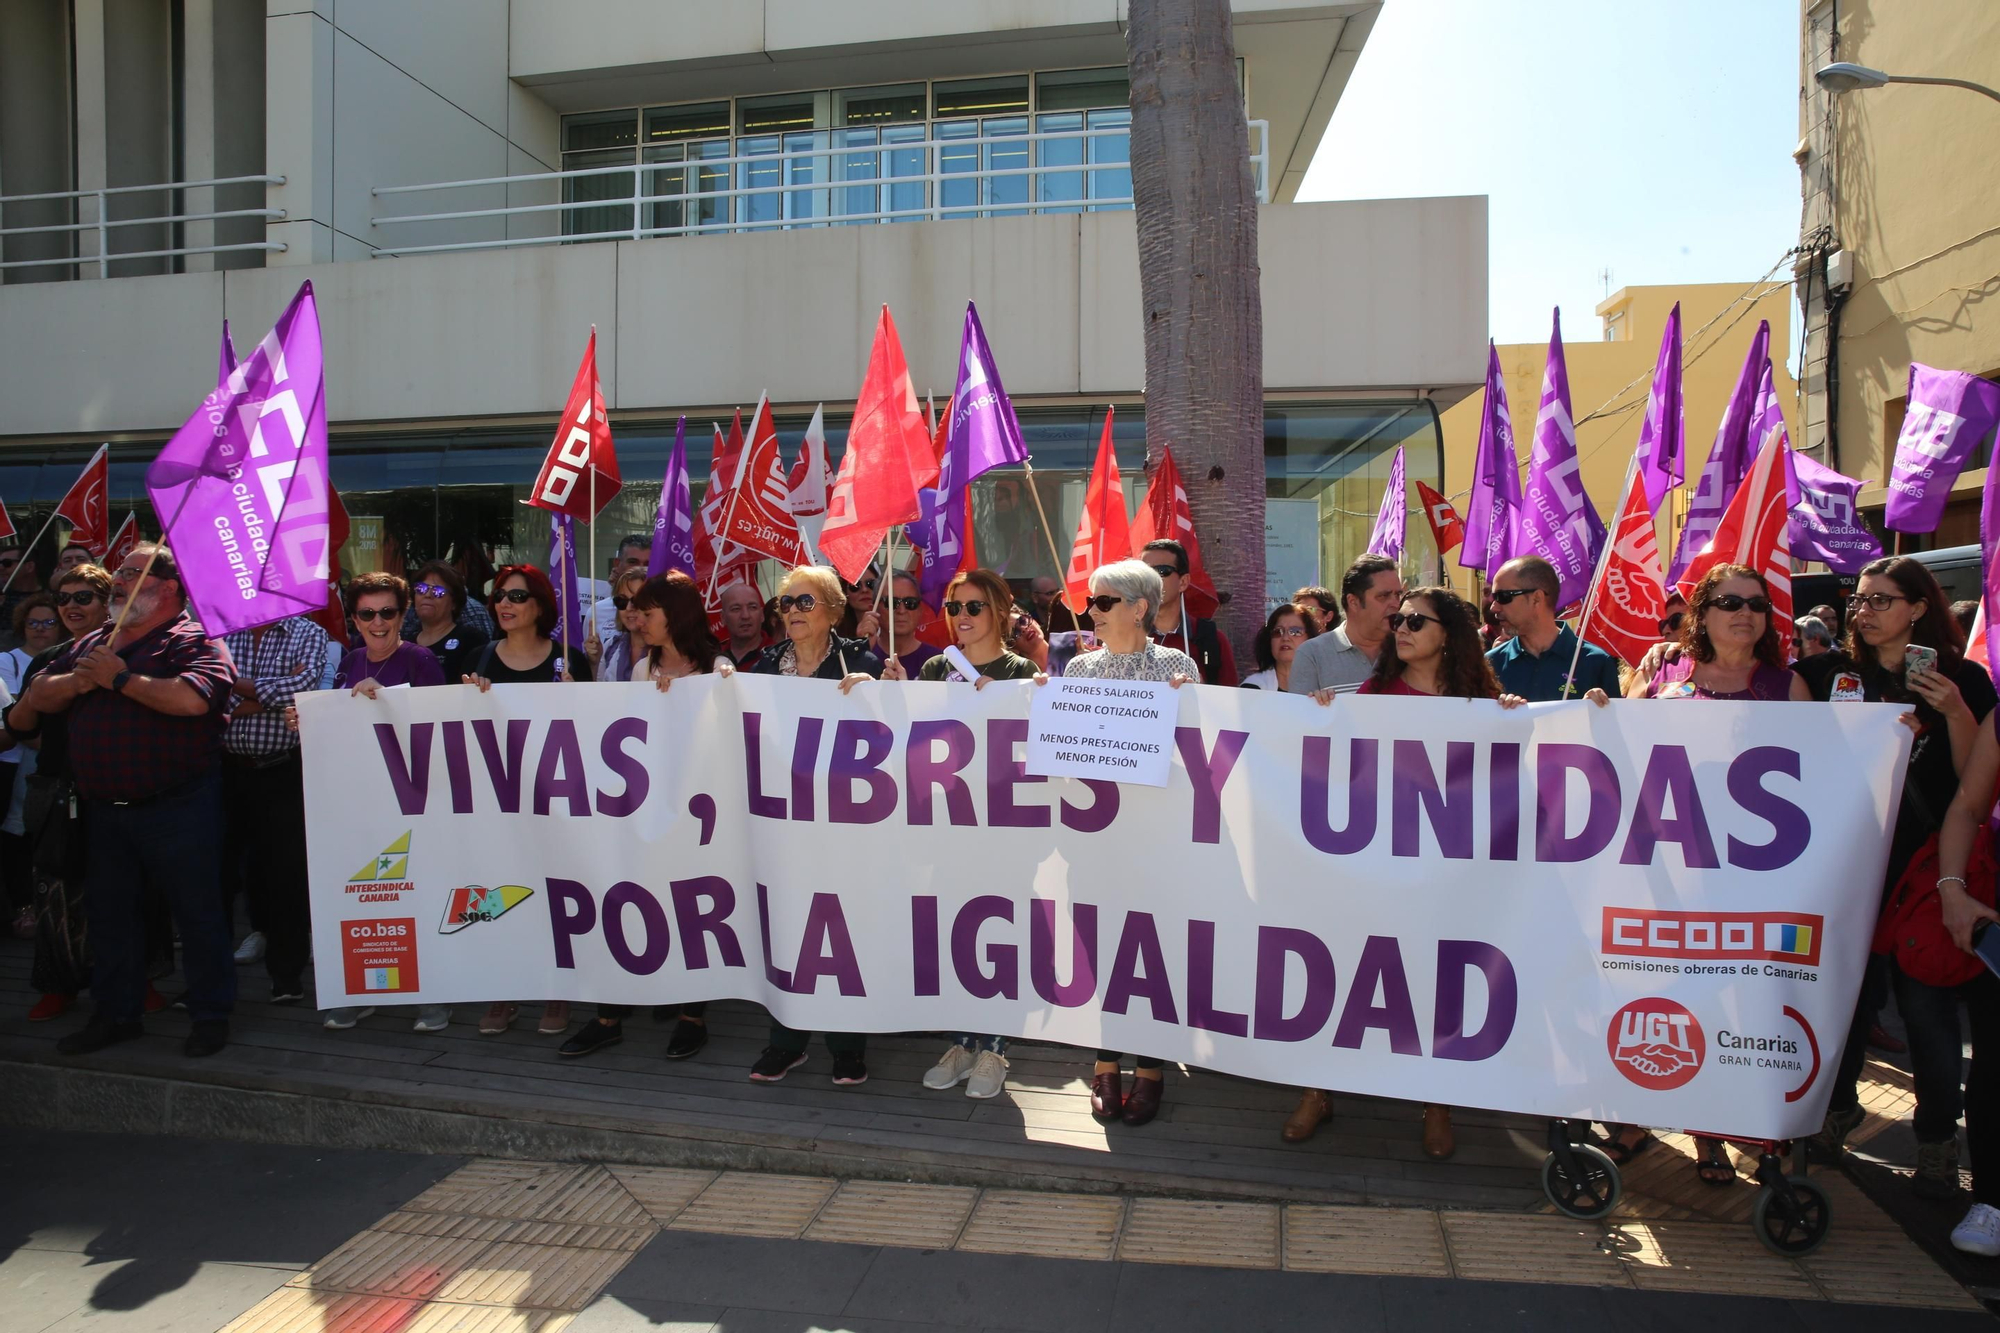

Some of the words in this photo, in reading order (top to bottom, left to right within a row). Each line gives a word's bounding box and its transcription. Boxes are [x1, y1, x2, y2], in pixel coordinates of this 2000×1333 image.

[358, 524, 377, 539] 8M
[1529, 487, 1582, 576] ciudadanía
[1828, 539, 1872, 551] canarias
[213, 515, 257, 601] canarias
[1062, 684, 1101, 696] PEORES
[1104, 687, 1154, 700] SALARIOS
[1051, 701, 1091, 713] MENOR
[1094, 705, 1159, 719] COTIZACIÓN
[1039, 733, 1078, 745] MENOS
[1081, 737, 1160, 754] PRESTACIONES
[1055, 751, 1096, 764] MENOR
[1098, 755, 1138, 768] PESIÓN
[374, 716, 650, 818] VIVAS
[1174, 726, 1250, 844] Y
[1300, 735, 1812, 872] UNIDAS
[345, 882, 415, 893] INTERSINDICAL
[358, 893, 400, 903] CANARIA
[350, 923, 407, 937] co.bas
[1612, 917, 1753, 950] CCOO
[364, 957, 398, 965] CANARIAS
[546, 875, 746, 976] POR
[757, 882, 867, 998] LA
[911, 895, 1518, 1062] IGUALDAD
[1602, 959, 1680, 974] comisiones
[1684, 964, 1736, 975] obreras
[1741, 963, 1759, 976] de
[1763, 965, 1818, 982] Canarias
[1618, 1011, 1691, 1051] UGT
[1717, 1030, 1797, 1054] Canarias
[1718, 1054, 1751, 1066] GRAN
[1756, 1058, 1802, 1071] CANARIA
